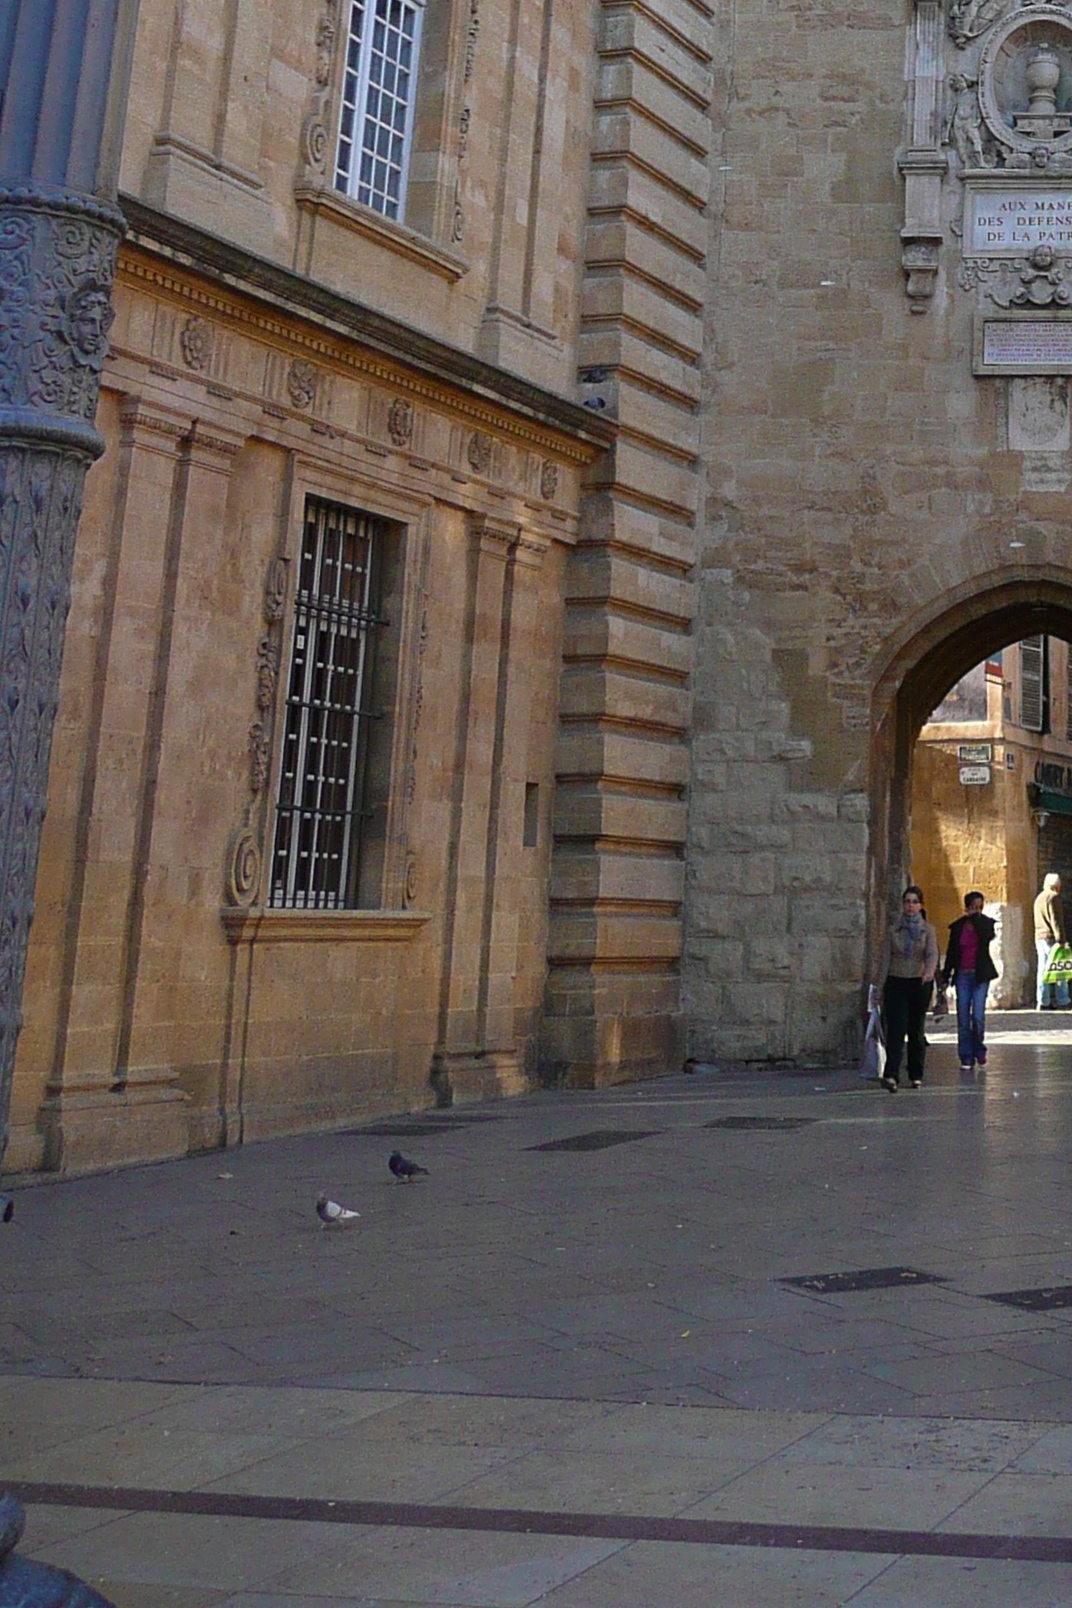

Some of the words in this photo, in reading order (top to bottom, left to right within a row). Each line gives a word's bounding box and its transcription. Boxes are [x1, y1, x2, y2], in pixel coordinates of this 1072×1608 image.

[999, 201, 1027, 211] AUX
[978, 216, 1004, 227] DES
[987, 232, 1005, 241] DE
[1012, 232, 1031, 241] LA
